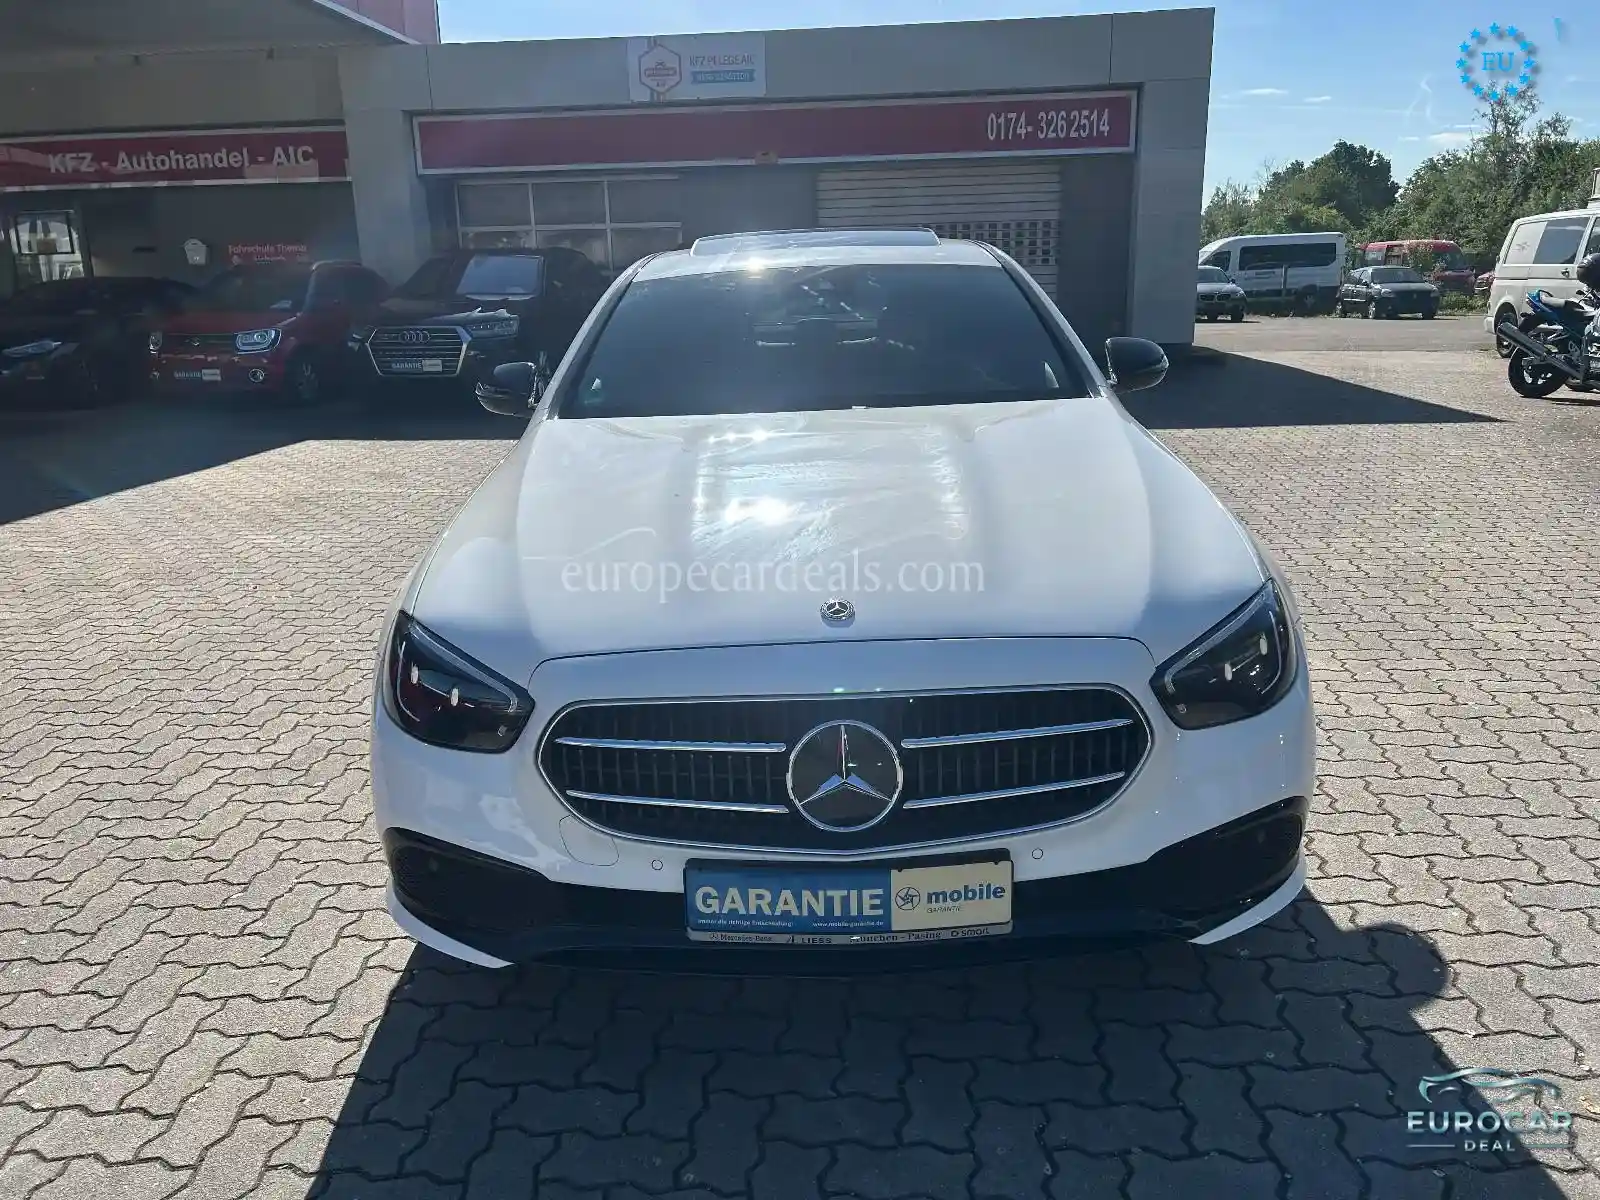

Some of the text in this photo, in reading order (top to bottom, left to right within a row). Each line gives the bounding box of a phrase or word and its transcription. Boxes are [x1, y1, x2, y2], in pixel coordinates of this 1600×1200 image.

[49, 152, 95, 173] KFZ
[116, 147, 249, 172] Autohandel
[272, 145, 315, 166] AIC
[694, 886, 884, 917] GARANTIE
[926, 882, 1006, 904] mobile
[961, 927, 989, 936] smart
